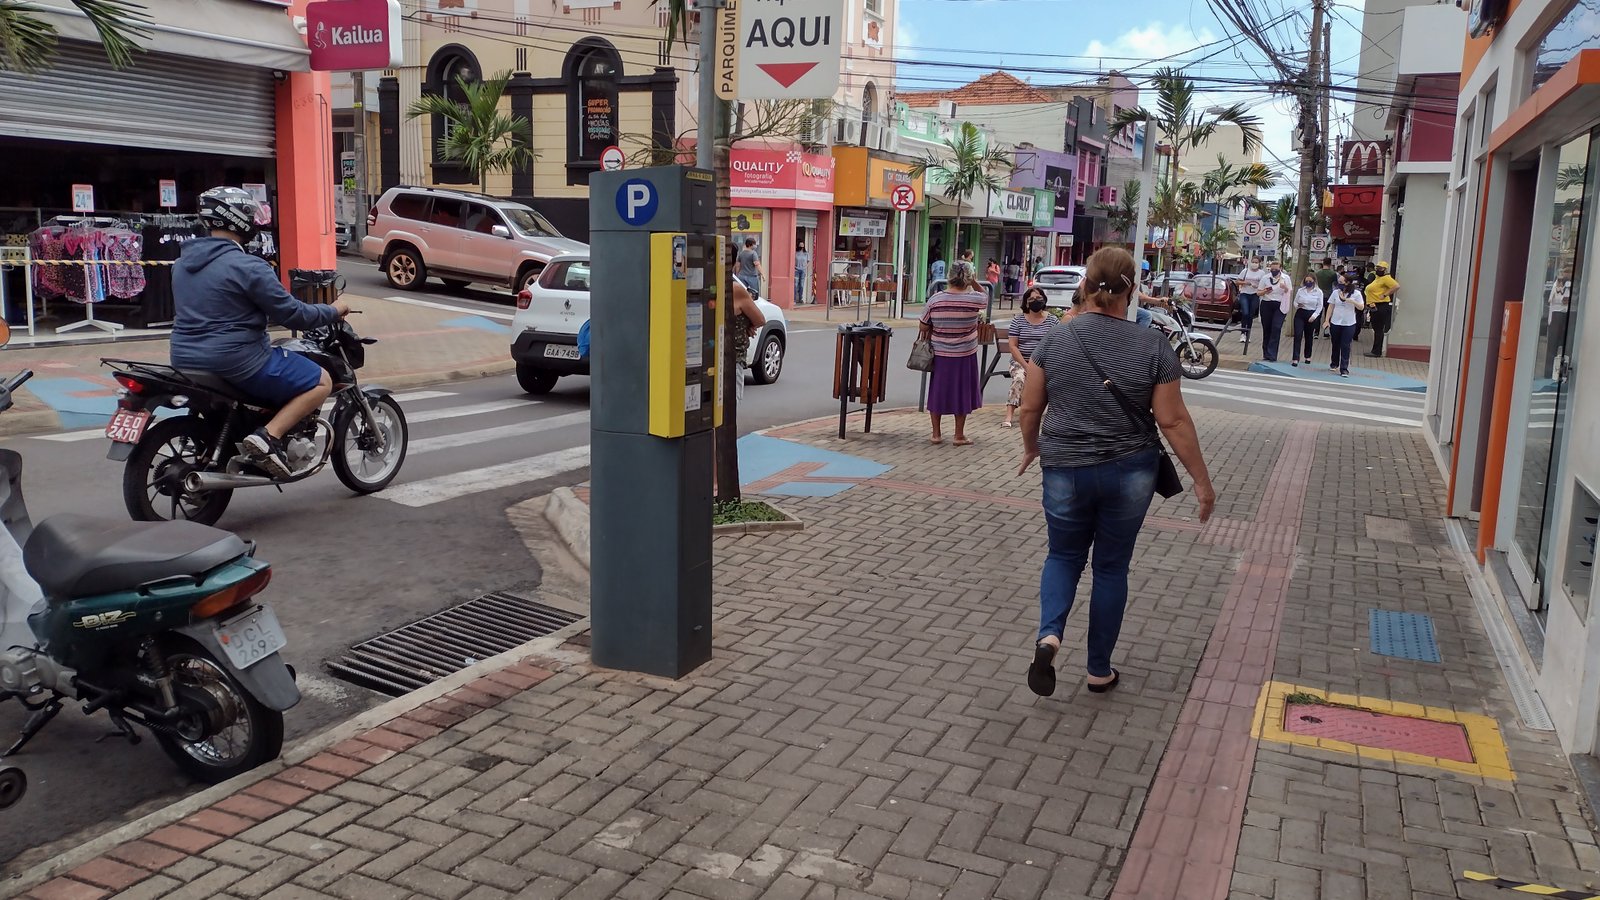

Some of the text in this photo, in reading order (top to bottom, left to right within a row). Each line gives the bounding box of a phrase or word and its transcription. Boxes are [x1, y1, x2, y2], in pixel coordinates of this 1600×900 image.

[331, 25, 383, 46] Kailua
[745, 15, 831, 48] AQUI
[627, 183, 651, 219] P
[1249, 223, 1257, 234] E
[1265, 230, 1272, 239] E
[1315, 240, 1322, 248] E
[107, 425, 139, 442] 2470
[81, 609, 122, 629] BIZ
